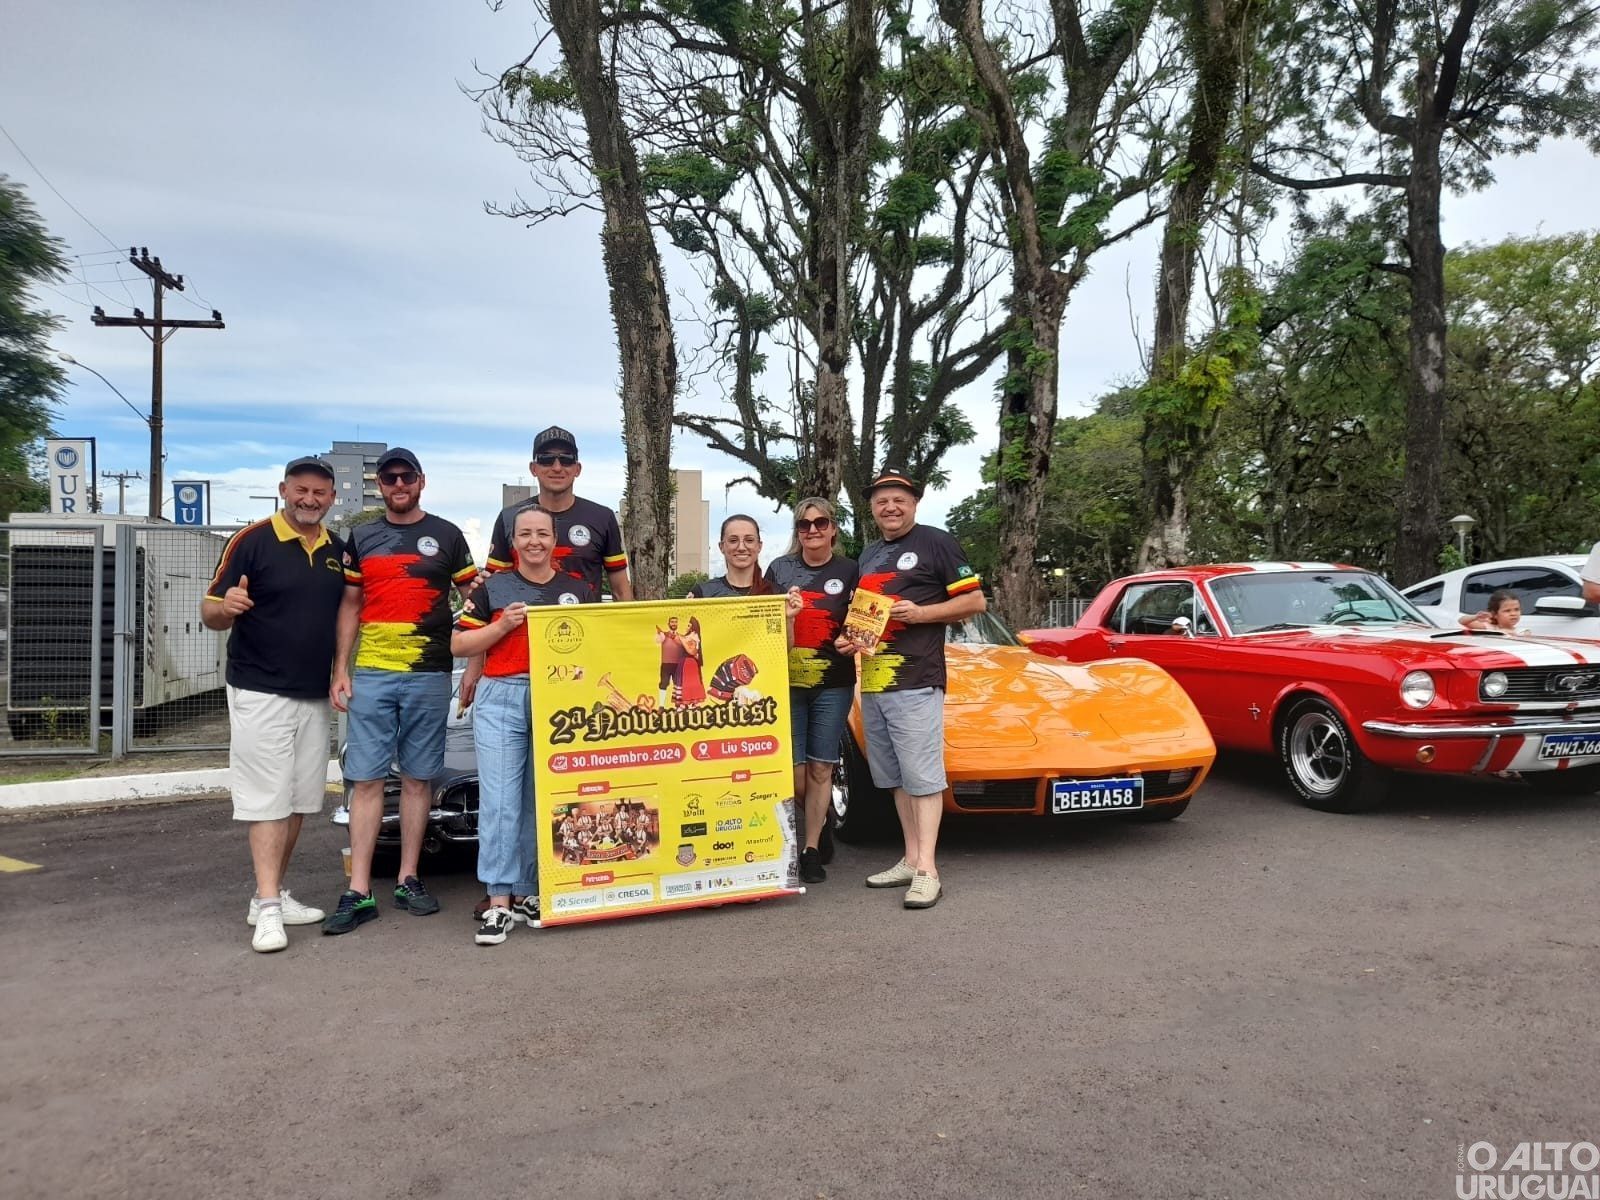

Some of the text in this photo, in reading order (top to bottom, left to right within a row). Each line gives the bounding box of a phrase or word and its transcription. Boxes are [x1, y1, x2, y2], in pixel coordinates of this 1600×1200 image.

[741, 741, 773, 755] Space
[1060, 788, 1134, 810] BEB1A58
[725, 818, 743, 826] ALTO
[618, 888, 650, 899] CRESOL
[568, 896, 597, 906] Sicredi
